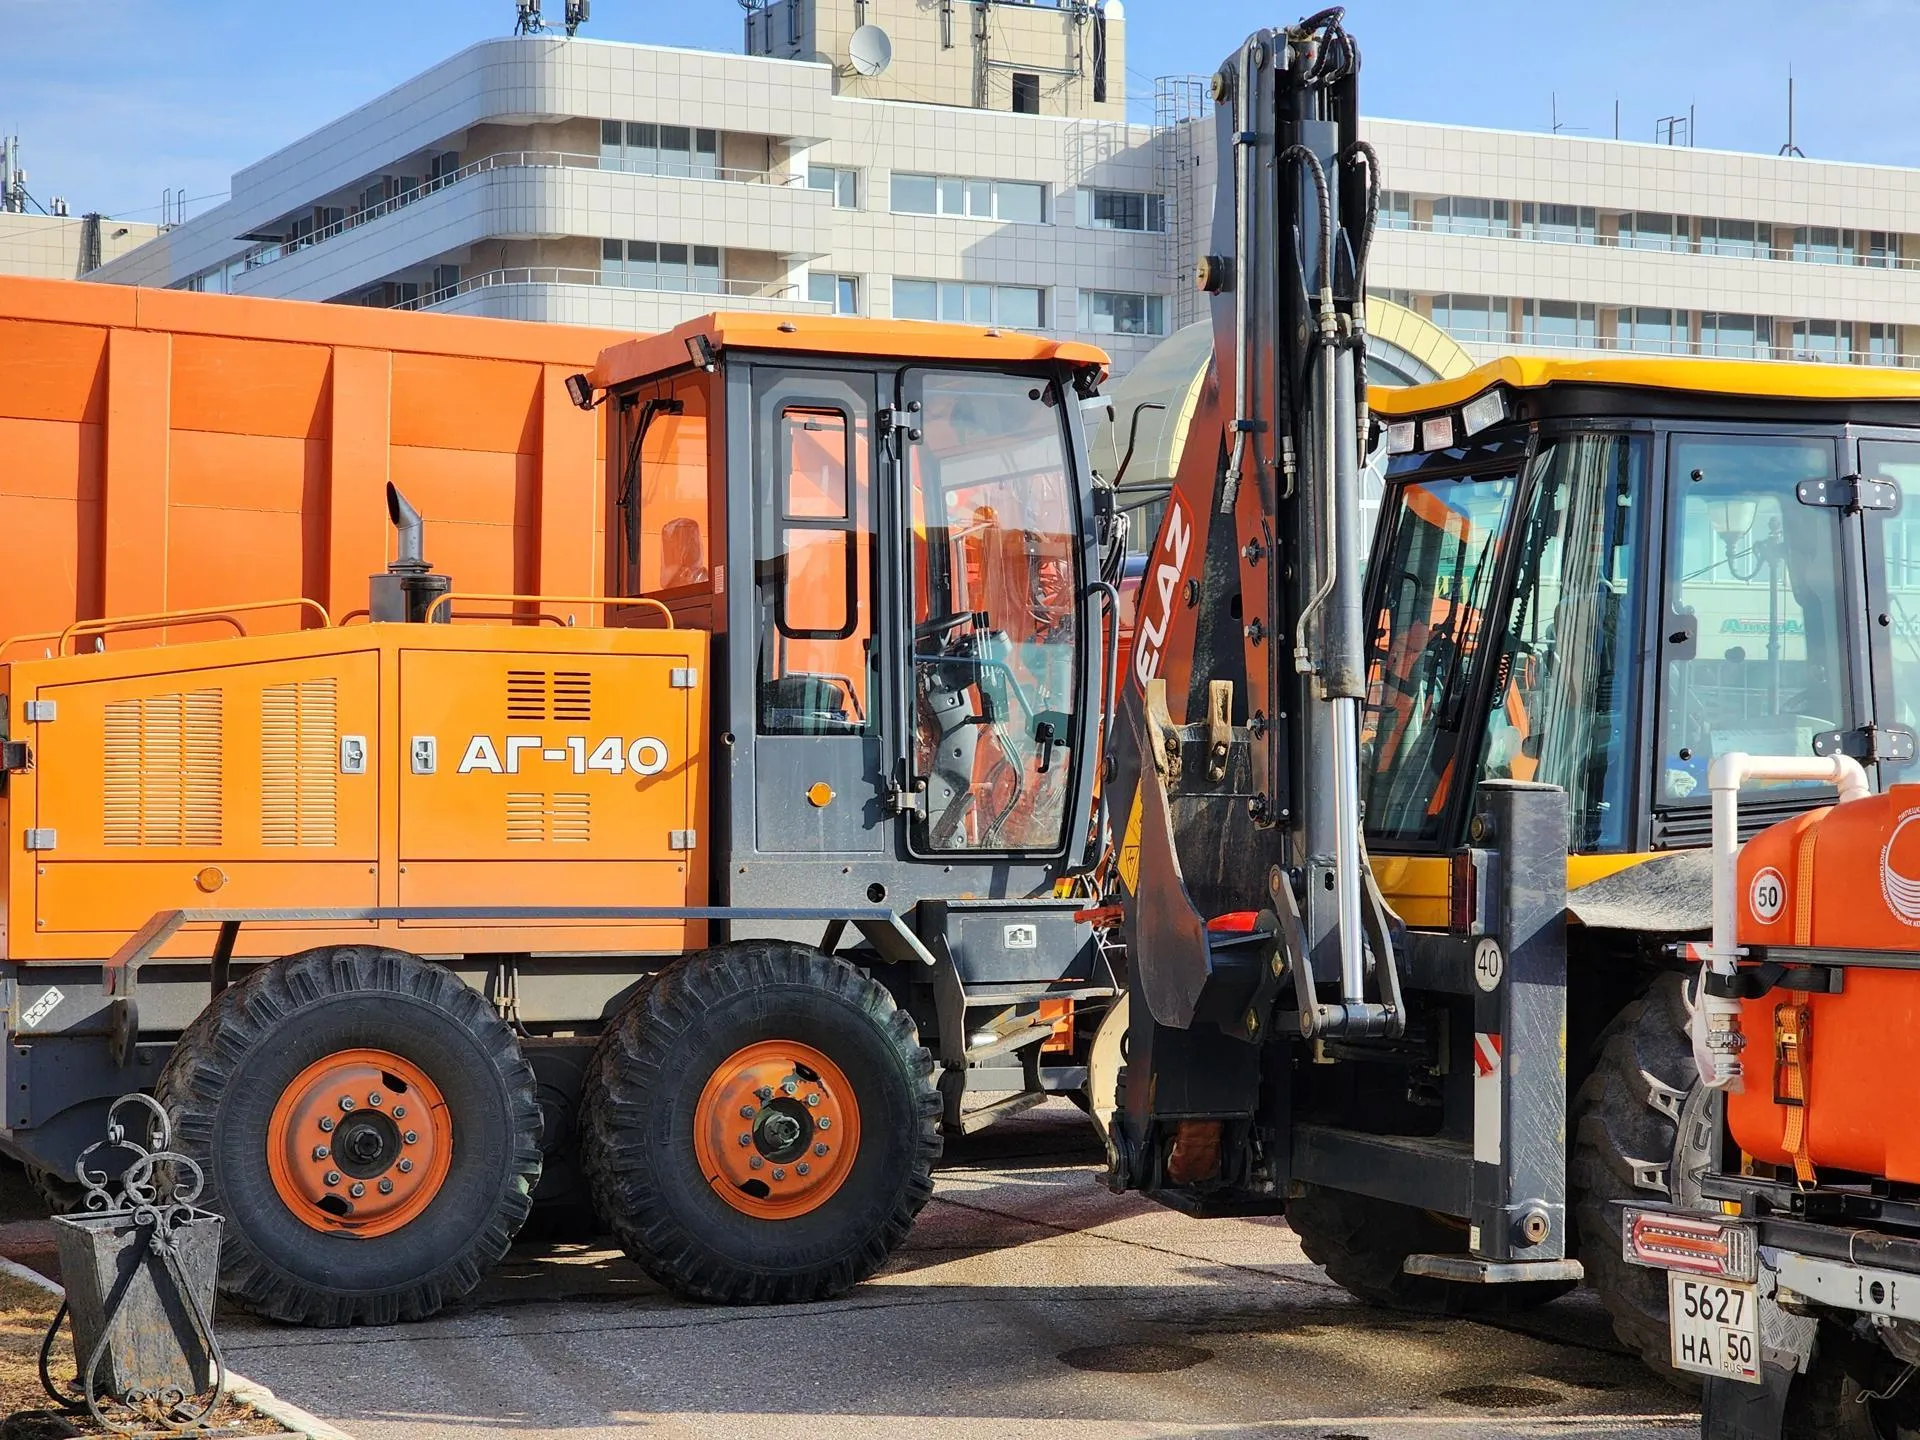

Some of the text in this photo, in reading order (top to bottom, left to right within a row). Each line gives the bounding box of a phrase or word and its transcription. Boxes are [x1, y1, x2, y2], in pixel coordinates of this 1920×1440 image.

[1137, 503, 1190, 688] ELAZ
[457, 736, 670, 776] АГ-140
[1758, 886, 1778, 908] 50
[1478, 948, 1498, 977] 40
[1684, 1282, 1744, 1325] 5627
[1681, 1333, 1751, 1366] НА 50
[1723, 1361, 1742, 1374] RUS
